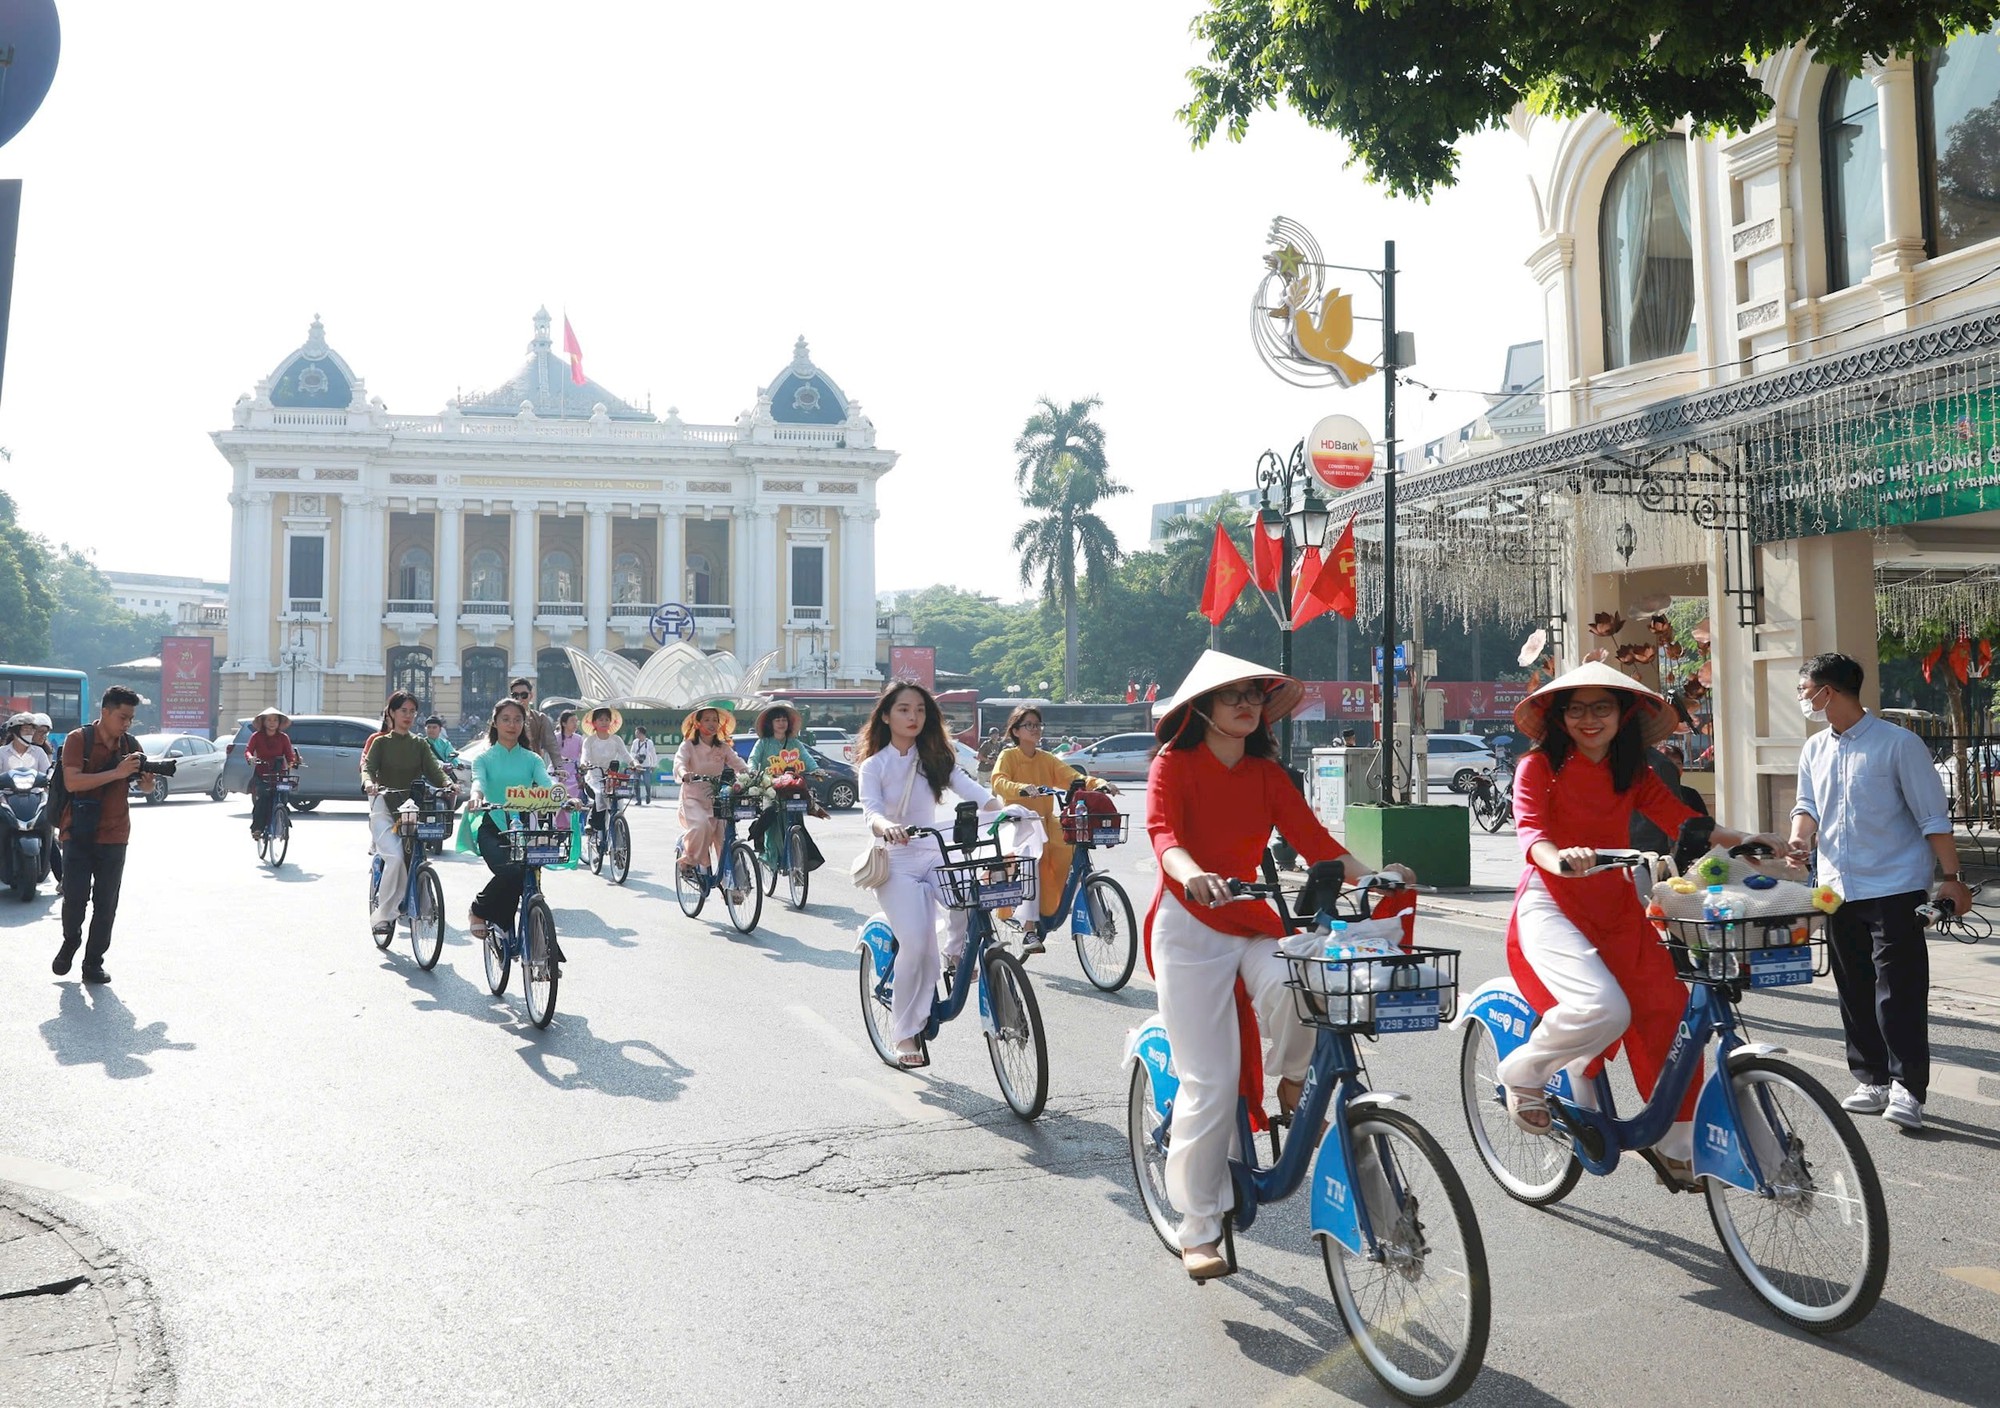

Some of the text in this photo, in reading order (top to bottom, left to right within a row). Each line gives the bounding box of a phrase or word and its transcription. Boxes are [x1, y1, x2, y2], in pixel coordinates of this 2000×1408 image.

[1320, 439, 1359, 451] HDBank
[1342, 687, 1365, 706] 2-9
[507, 786, 549, 801] HÀ NỘI
[1488, 1008, 1512, 1033] TNGO
[1706, 1122, 1729, 1148] TN
[1325, 1175, 1347, 1204] TN
